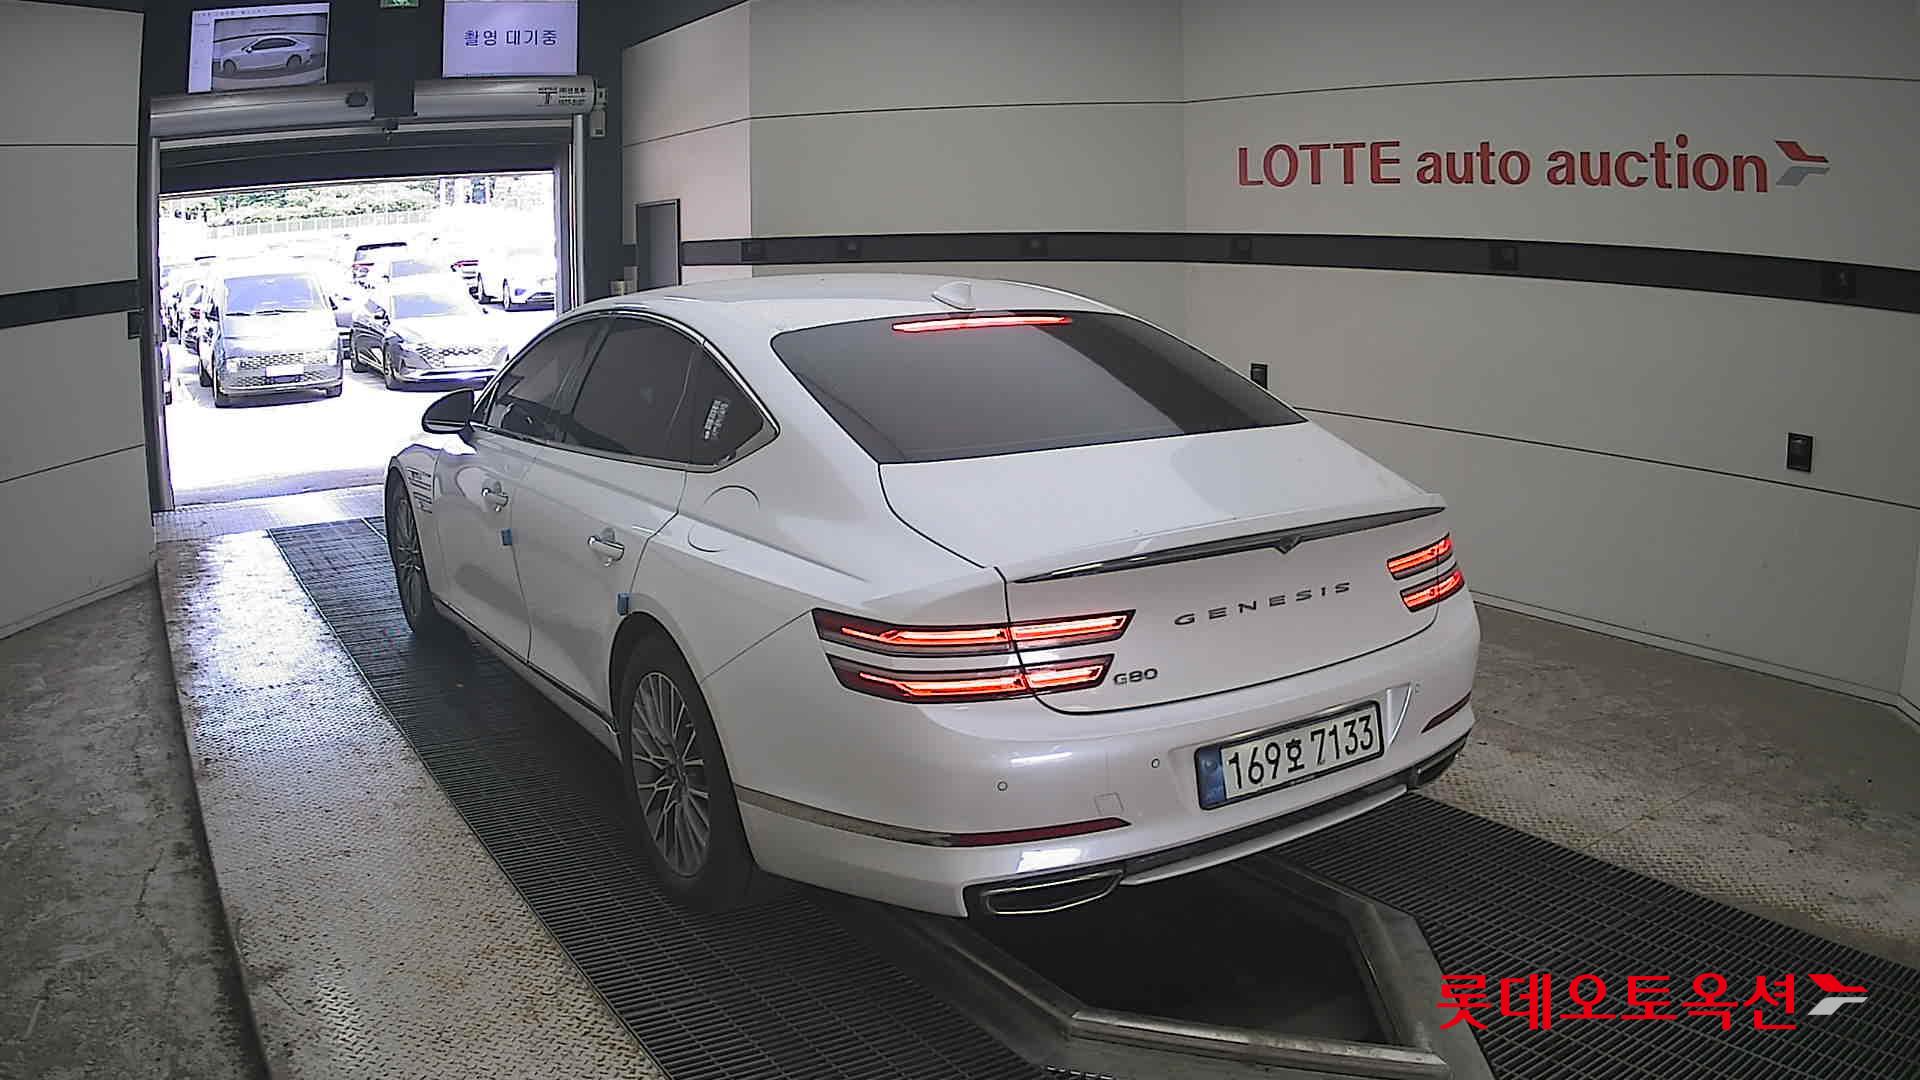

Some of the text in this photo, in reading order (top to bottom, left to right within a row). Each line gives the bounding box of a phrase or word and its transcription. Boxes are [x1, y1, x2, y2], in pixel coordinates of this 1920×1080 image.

[506, 29, 557, 46] 대기중
[1238, 134, 1768, 193] LOTTE auto auction
[1174, 582, 1351, 626] GENESIS
[1113, 667, 1159, 685] G80
[1228, 714, 1374, 790] 169호 7133
